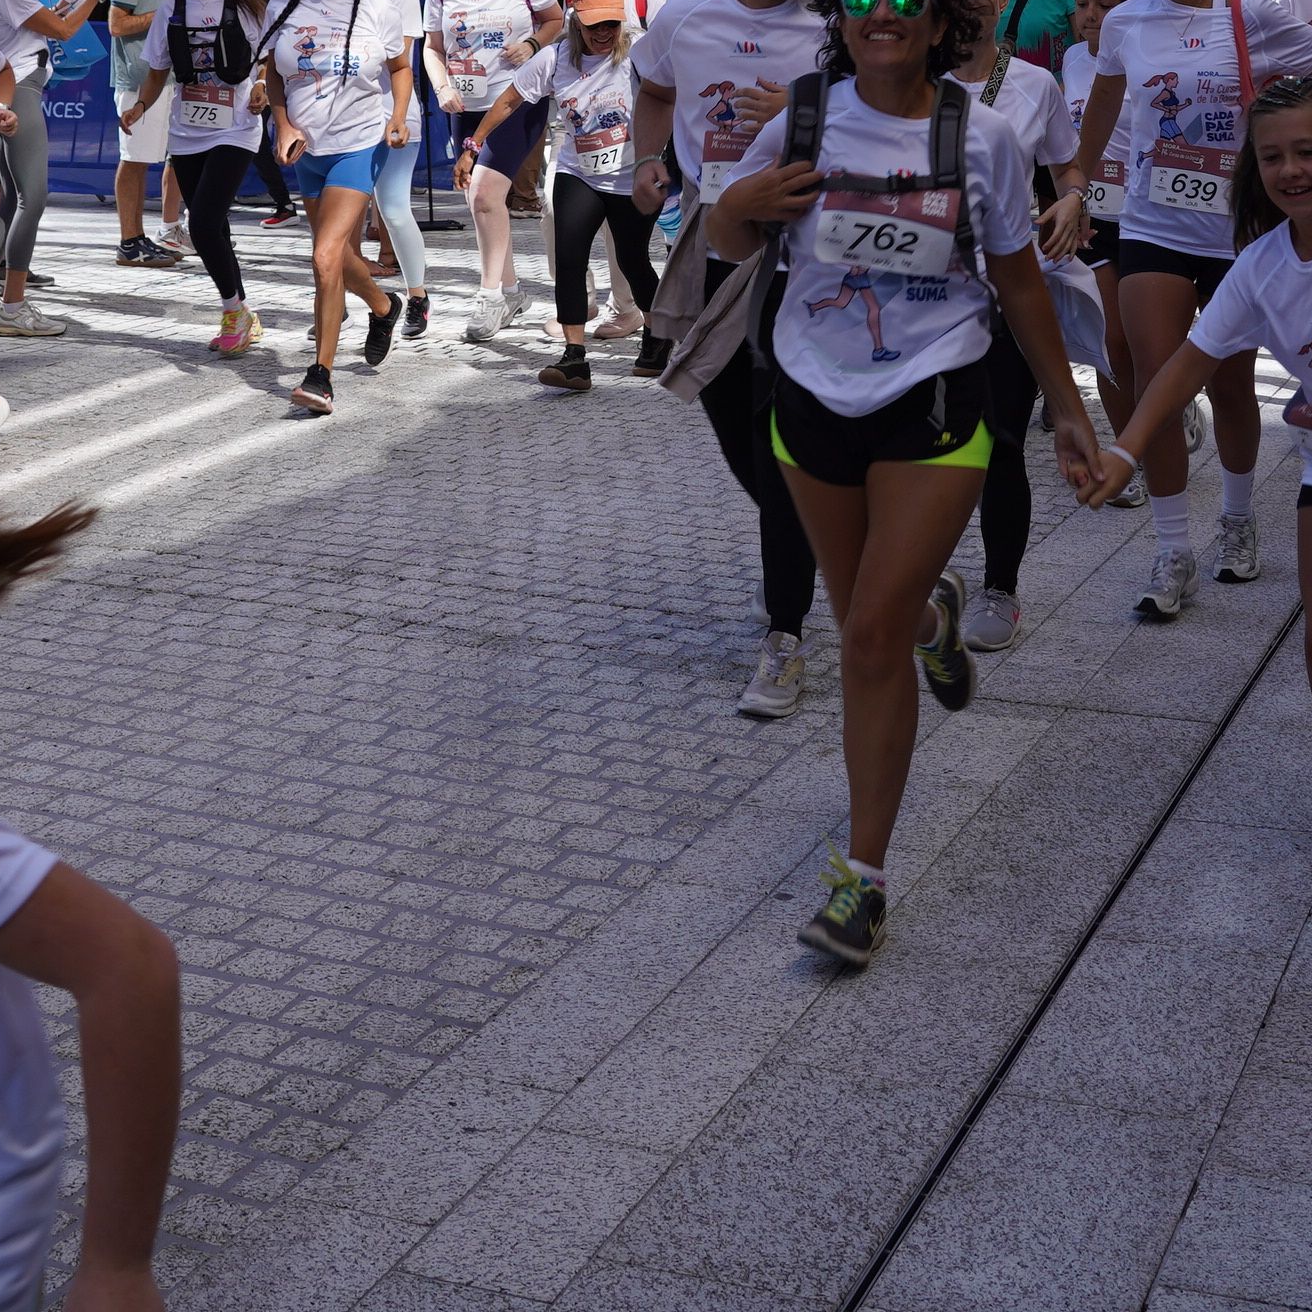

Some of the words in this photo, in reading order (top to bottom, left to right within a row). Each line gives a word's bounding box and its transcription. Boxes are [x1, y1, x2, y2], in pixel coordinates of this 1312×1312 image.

[734, 41, 762, 53] ADA
[455, 77, 474, 92] 635
[41, 101, 85, 118] NCES
[191, 105, 218, 121] 775
[1204, 111, 1234, 121] CADA
[1205, 121, 1235, 132] PAS
[591, 148, 618, 169] 727
[1171, 173, 1217, 202] 639
[848, 222, 919, 254] 762
[906, 287, 948, 301] SUMA
